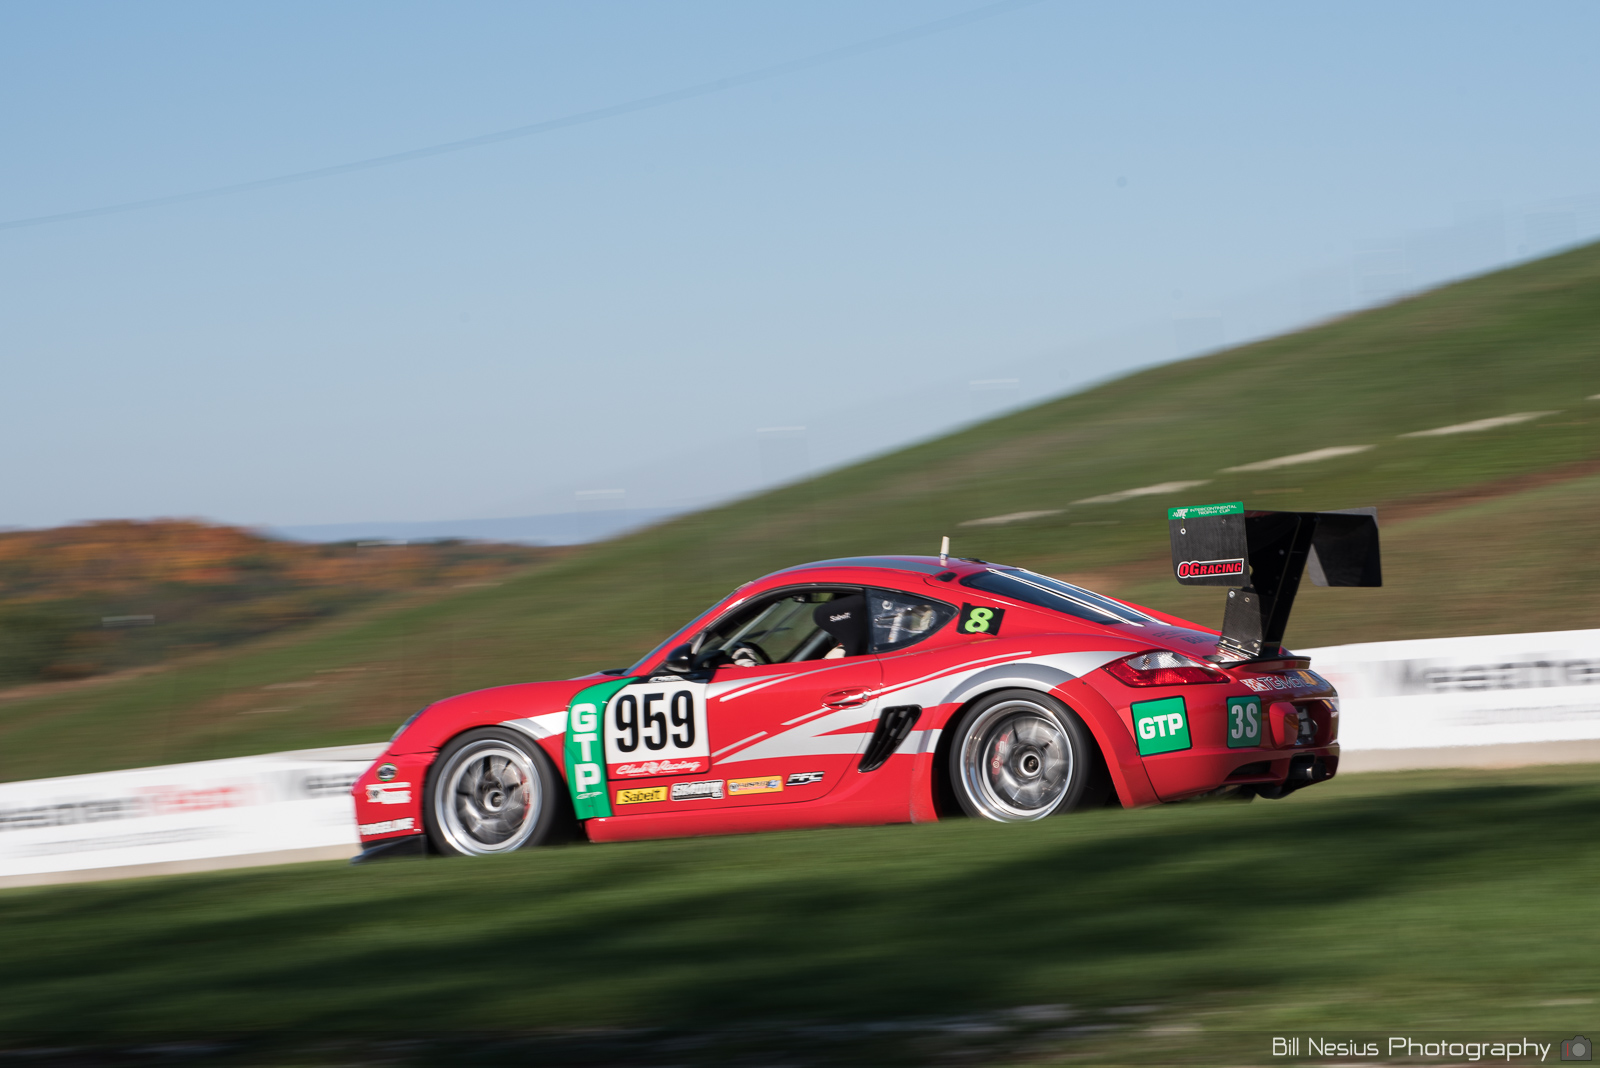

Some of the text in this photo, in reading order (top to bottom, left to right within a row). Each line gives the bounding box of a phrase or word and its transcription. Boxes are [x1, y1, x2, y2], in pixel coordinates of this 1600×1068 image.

[1189, 504, 1237, 512] INTERCONTINENTAL
[964, 607, 994, 633] 8
[615, 690, 695, 753] 959
[1138, 713, 1184, 740] GTP
[1231, 703, 1258, 739] 3S
[571, 703, 601, 793] GTP
[622, 790, 662, 802] Sabelt
